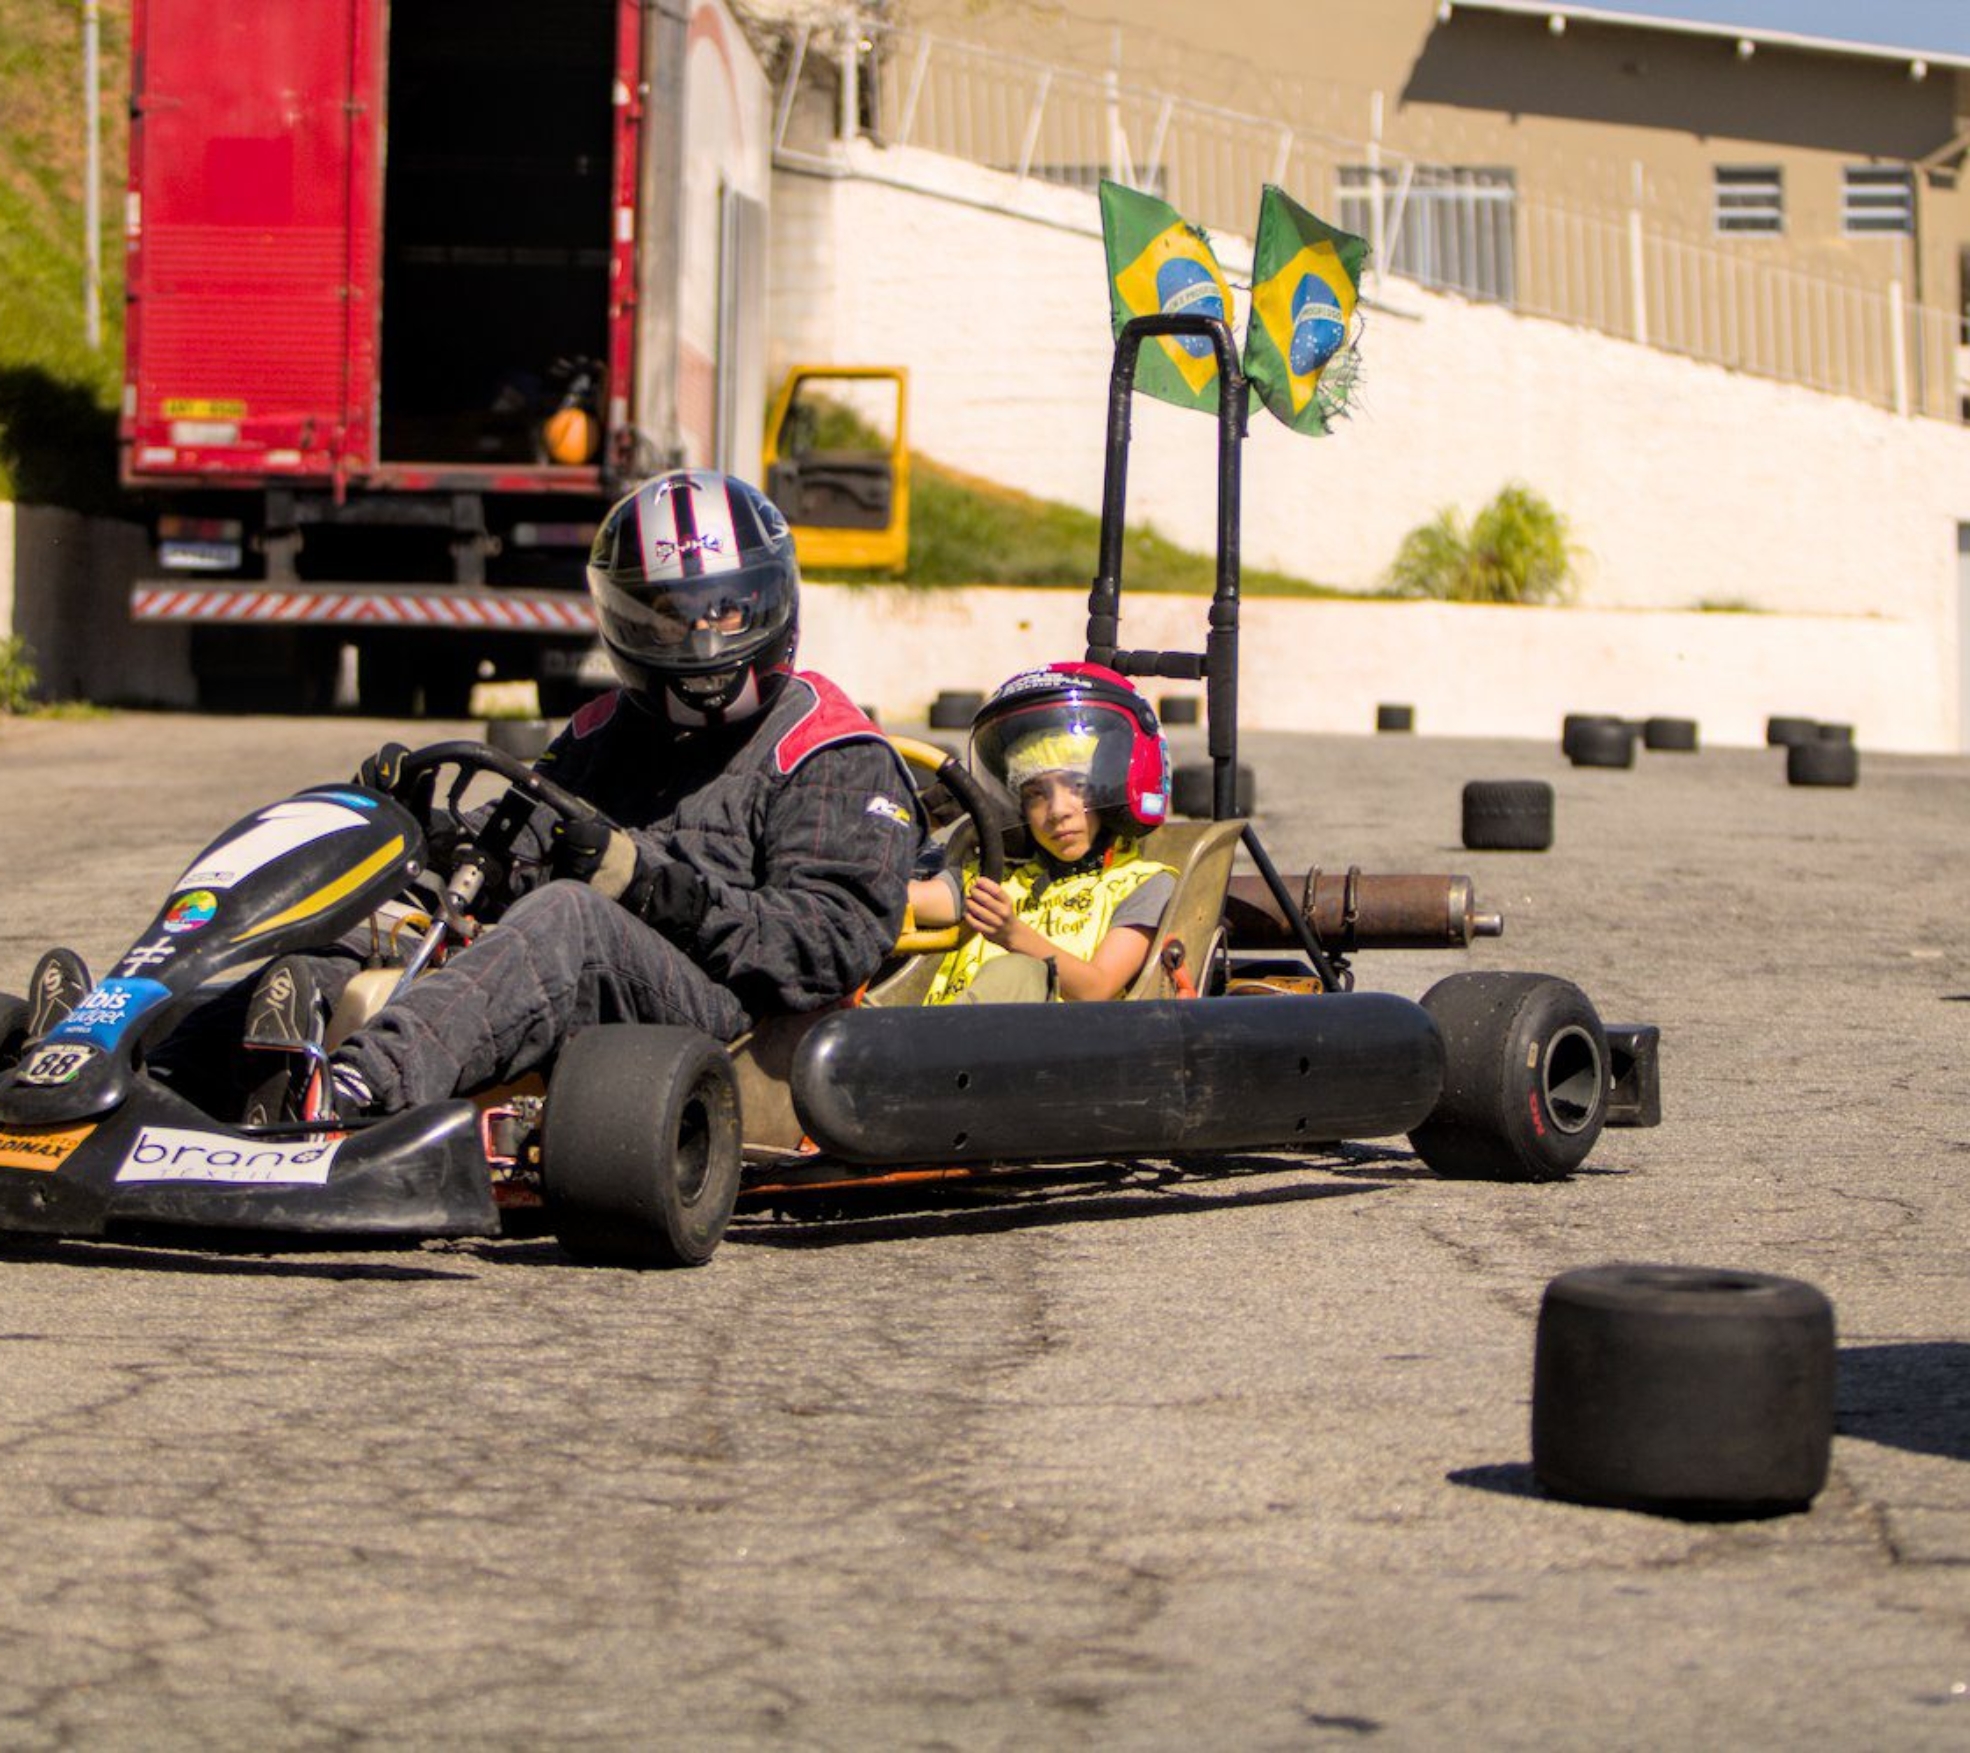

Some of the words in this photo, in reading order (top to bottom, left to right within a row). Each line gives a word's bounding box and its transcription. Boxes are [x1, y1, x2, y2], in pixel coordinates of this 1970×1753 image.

[80, 986, 132, 1009] ibis
[31, 1053, 82, 1076] 88
[132, 1133, 332, 1168] brand
